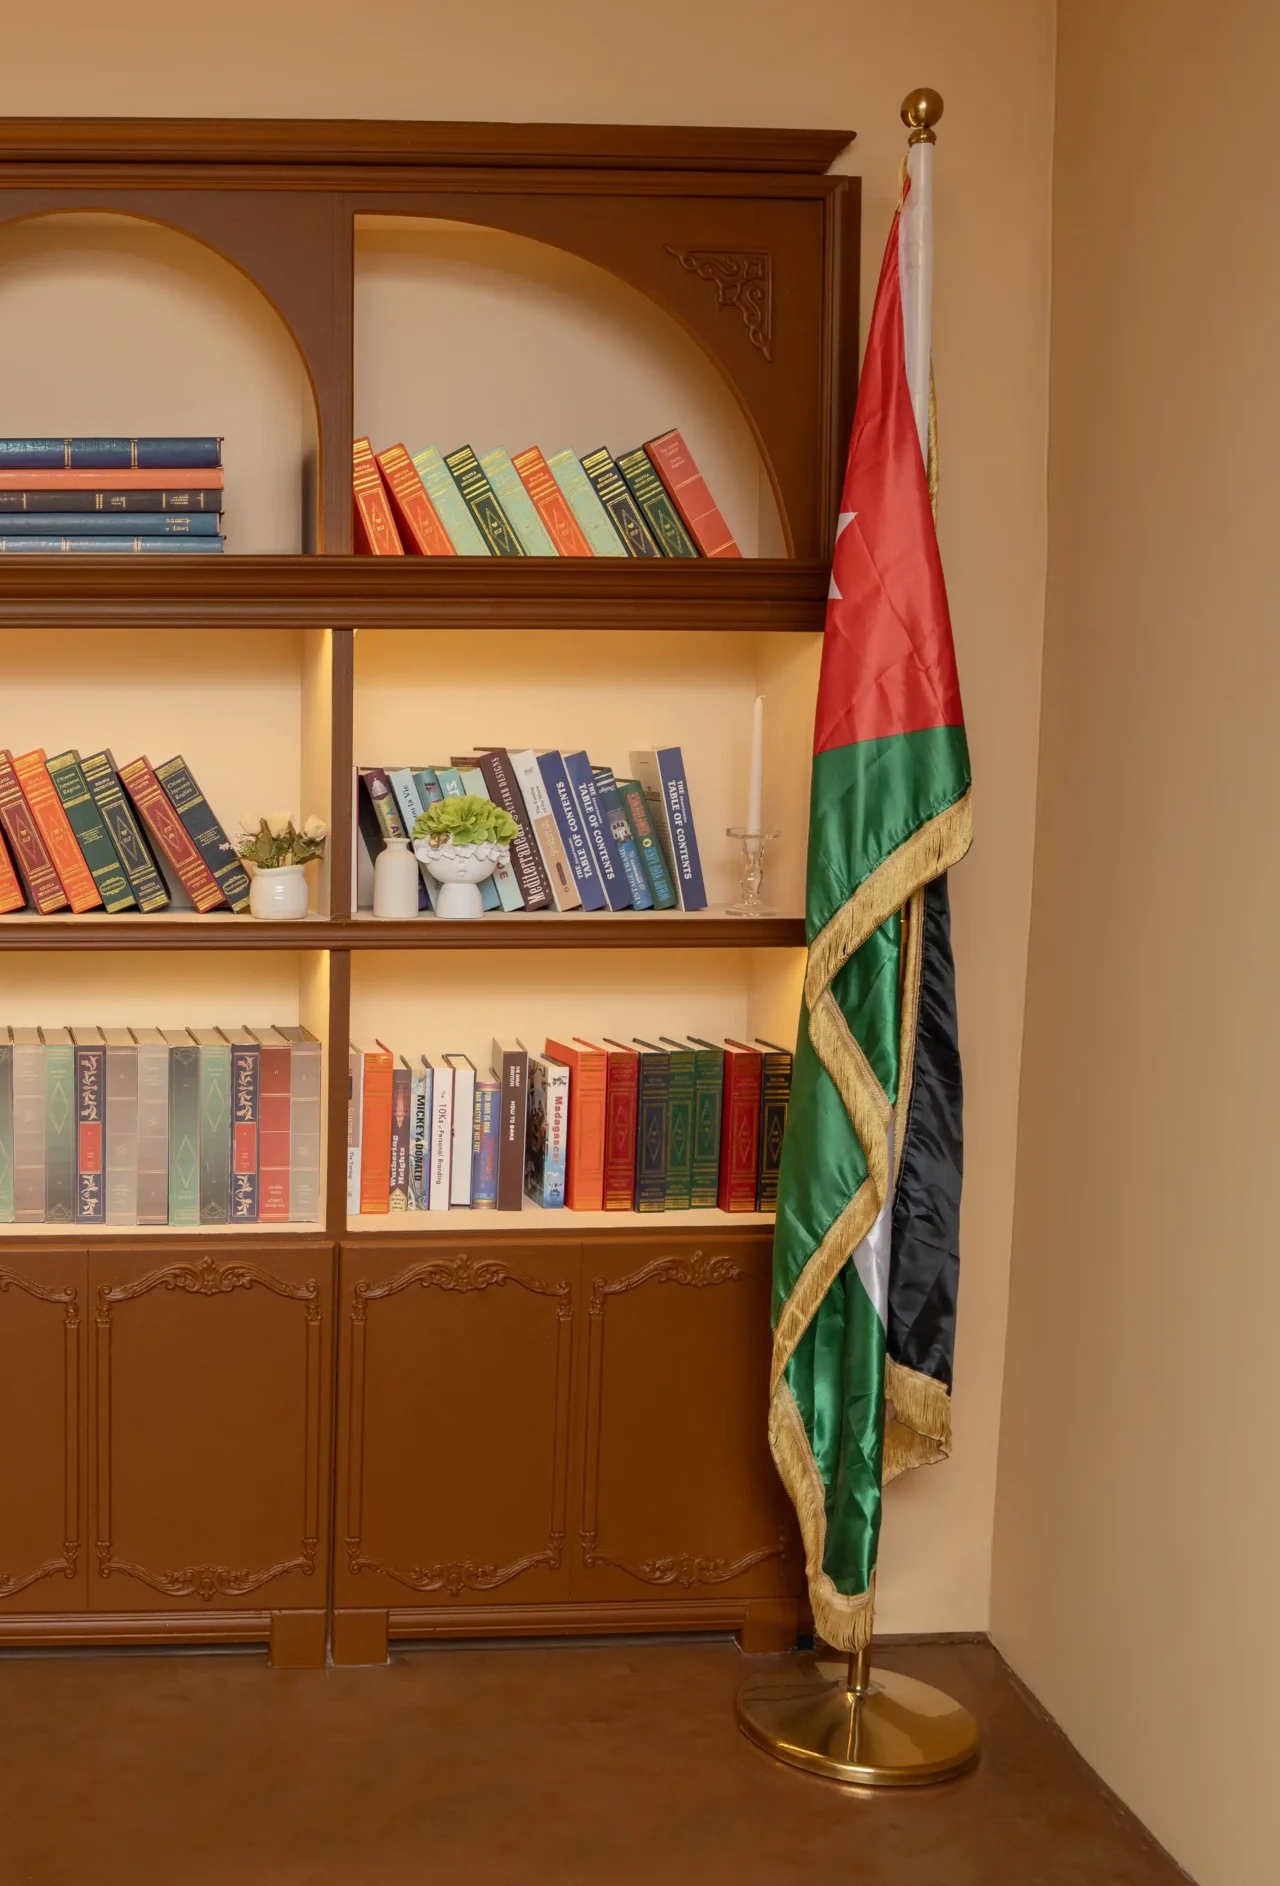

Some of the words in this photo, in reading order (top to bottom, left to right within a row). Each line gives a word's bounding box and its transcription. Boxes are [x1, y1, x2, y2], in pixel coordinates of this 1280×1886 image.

[56, 772, 76, 783] Chinese
[167, 776, 187, 790] Chinese
[491, 757, 506, 788] DESIGNS
[175, 786, 193, 801] English
[403, 784, 411, 800] Vie
[501, 788, 516, 815] SUPERB
[578, 783, 590, 814] TABLE
[667, 780, 677, 812] TABLE
[556, 781, 577, 832] CONTENTS
[627, 791, 651, 836] CONFIDENCE
[589, 814, 599, 829] OF
[673, 812, 683, 828] OF
[573, 832, 583, 845] OF
[578, 848, 592, 879] TABLE
[593, 829, 615, 880] CONTENTS
[644, 846, 659, 865] LIKE
[677, 828, 692, 880] CONTENTS
[574, 866, 583, 879] THE
[649, 863, 663, 879] YOU
[654, 878, 671, 901] WHAT
[484, 1091, 492, 1101] FOR
[437, 1103, 447, 1124] 10Ks
[474, 1101, 482, 1123] MASTER
[483, 1113, 491, 1121] IS
[483, 1121, 491, 1133] MAN
[437, 1130, 445, 1159] Personal
[390, 1134, 399, 1187] Wuthering
[414, 1143, 423, 1181] DONALD
[435, 1159, 444, 1185] Branding
